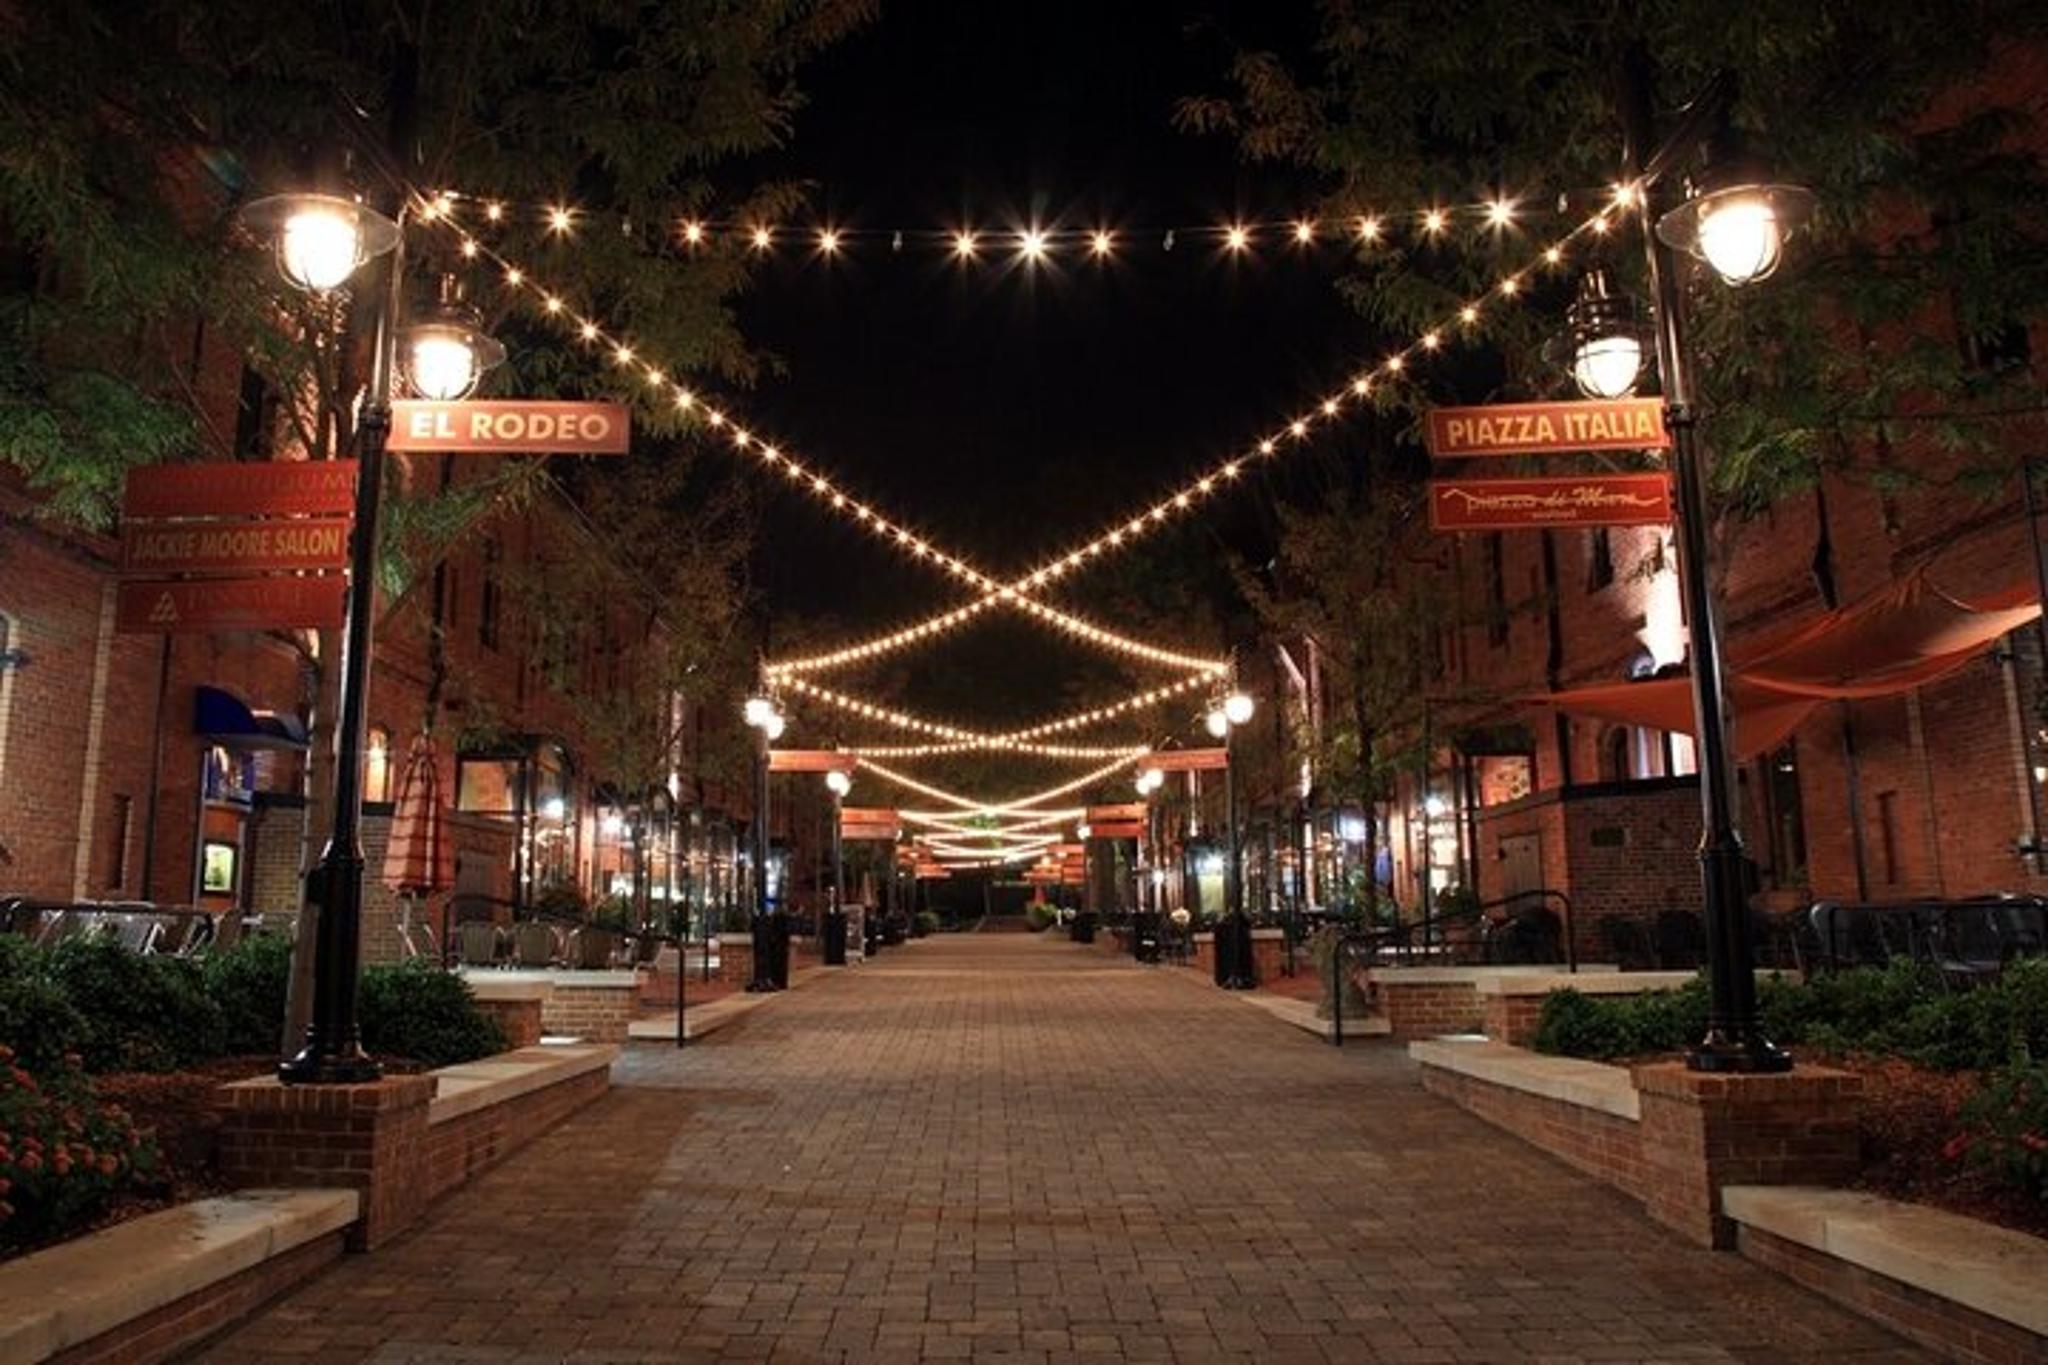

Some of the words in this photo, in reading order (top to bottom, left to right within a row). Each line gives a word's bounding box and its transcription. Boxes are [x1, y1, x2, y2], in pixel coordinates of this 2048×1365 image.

[410, 411, 456, 439] EL
[470, 411, 610, 441] RODEO
[1447, 414, 1556, 447] PIAZZA
[1563, 410, 1656, 441] ITALIA
[201, 530, 272, 558] MOORE
[275, 527, 340, 557] SALON
